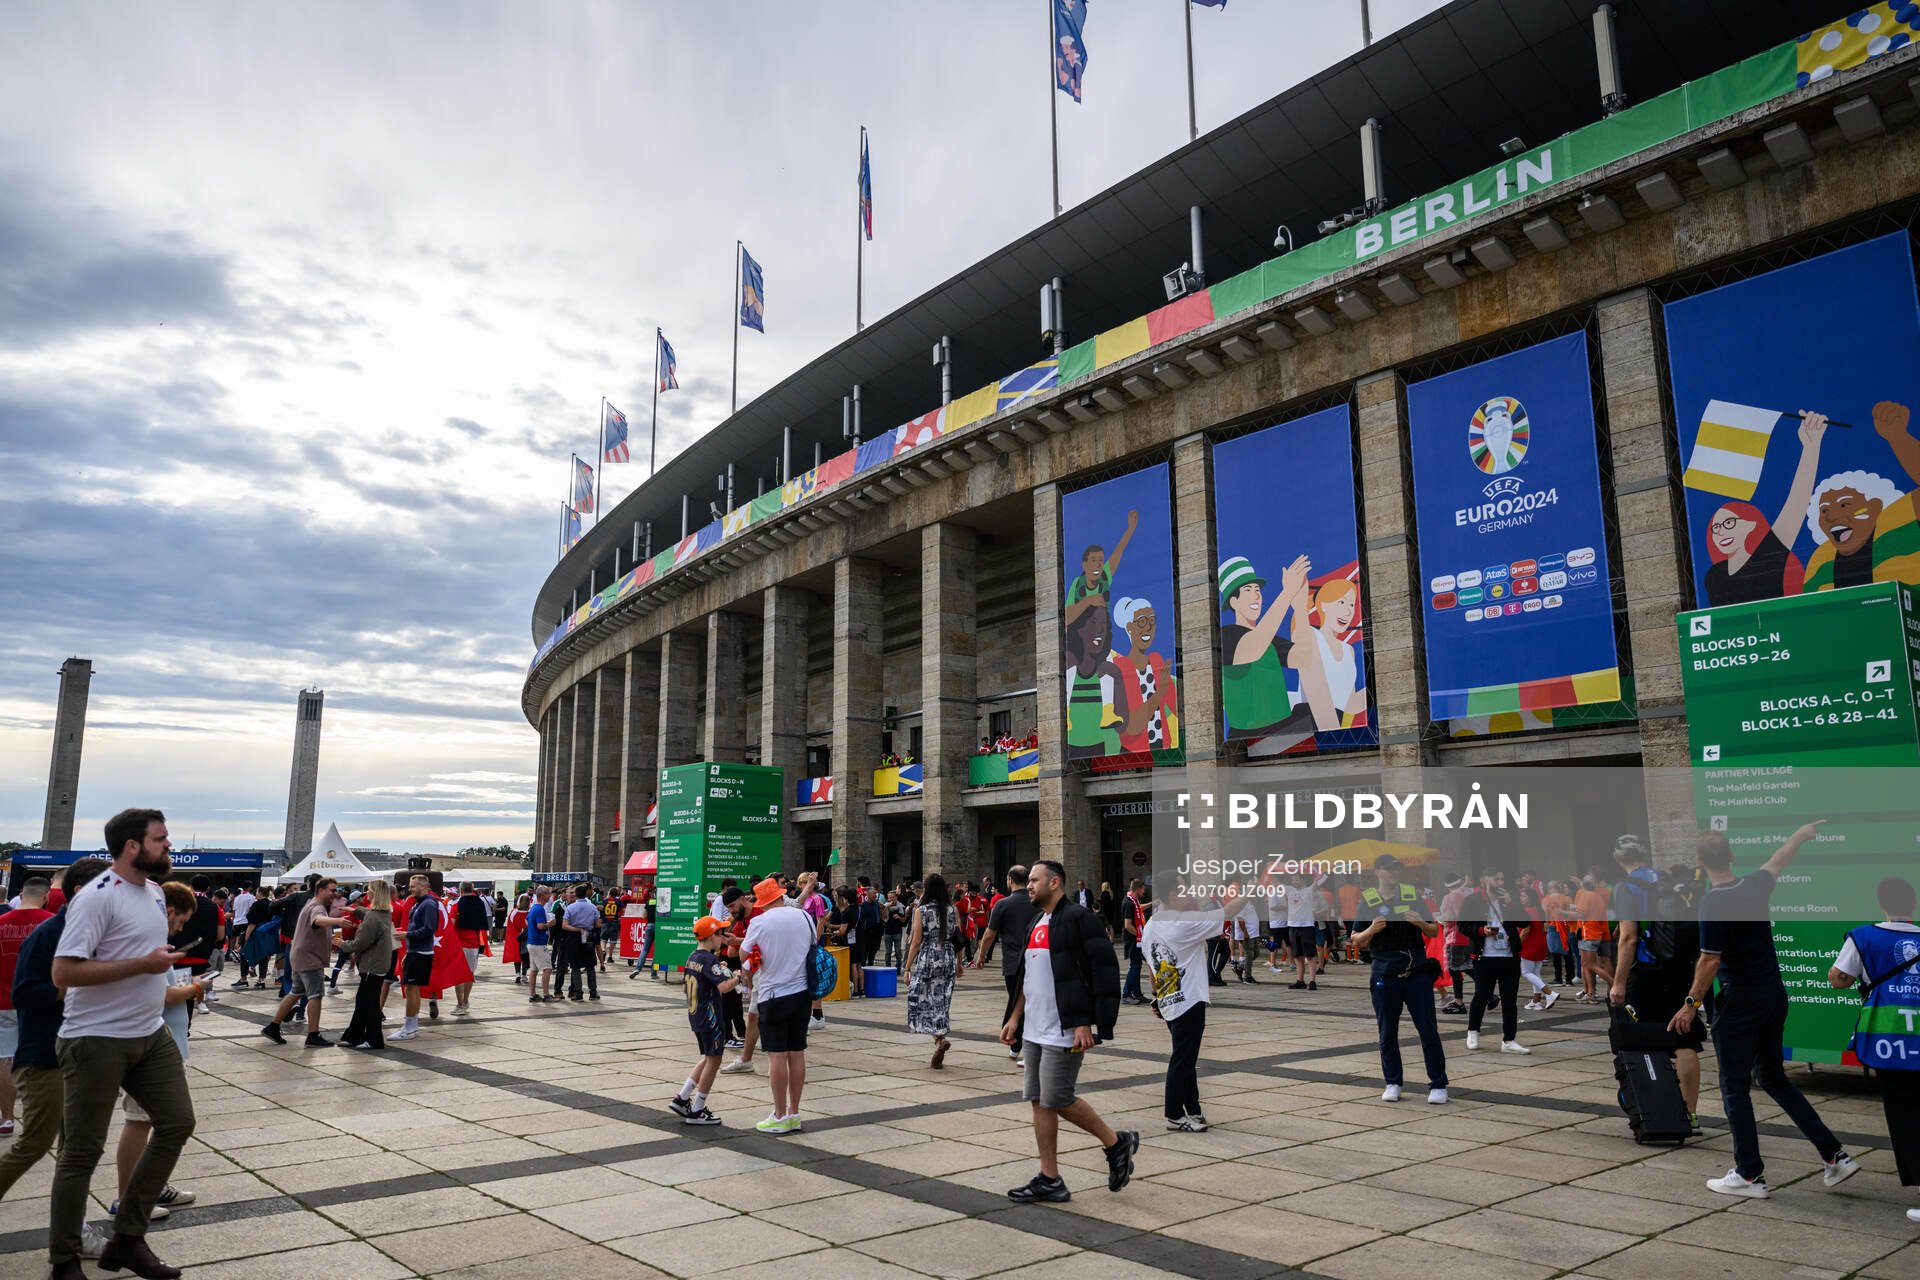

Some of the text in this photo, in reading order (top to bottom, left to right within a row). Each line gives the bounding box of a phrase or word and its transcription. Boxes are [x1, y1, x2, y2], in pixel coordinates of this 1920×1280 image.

[1355, 149, 1552, 259] BERLIN
[1484, 479, 1520, 498] UEFA
[1455, 487, 1559, 526] EURO2024
[1478, 513, 1534, 534] GERMANY
[1569, 570, 1597, 581] vivo
[1524, 601, 1541, 609] ERGO
[1487, 608, 1499, 616] DB
[1692, 636, 1745, 654] BLOCKS
[1693, 654, 1748, 671] BLOCKS
[1760, 695, 1818, 712] BLOCKS
[1741, 717, 1790, 732] BLOCK
[1828, 712, 1841, 724] &
[1705, 766, 1793, 779] PARTNER VILLAGE
[1706, 780, 1800, 793] The Maifeld Garden
[1708, 795, 1787, 807] The Maifeld Club
[1110, 802, 1162, 815] OBERRING
[1728, 835, 1762, 845] adcast
[1763, 835, 1772, 844] &
[169, 854, 199, 864] SHOP
[1776, 874, 1811, 883] atform
[604, 903, 618, 915] 60
[1807, 904, 1838, 913] Room
[633, 922, 646, 943] ICE
[1772, 933, 1794, 942] dios
[1779, 963, 1818, 973] Studios
[1898, 1008, 1920, 1032] T
